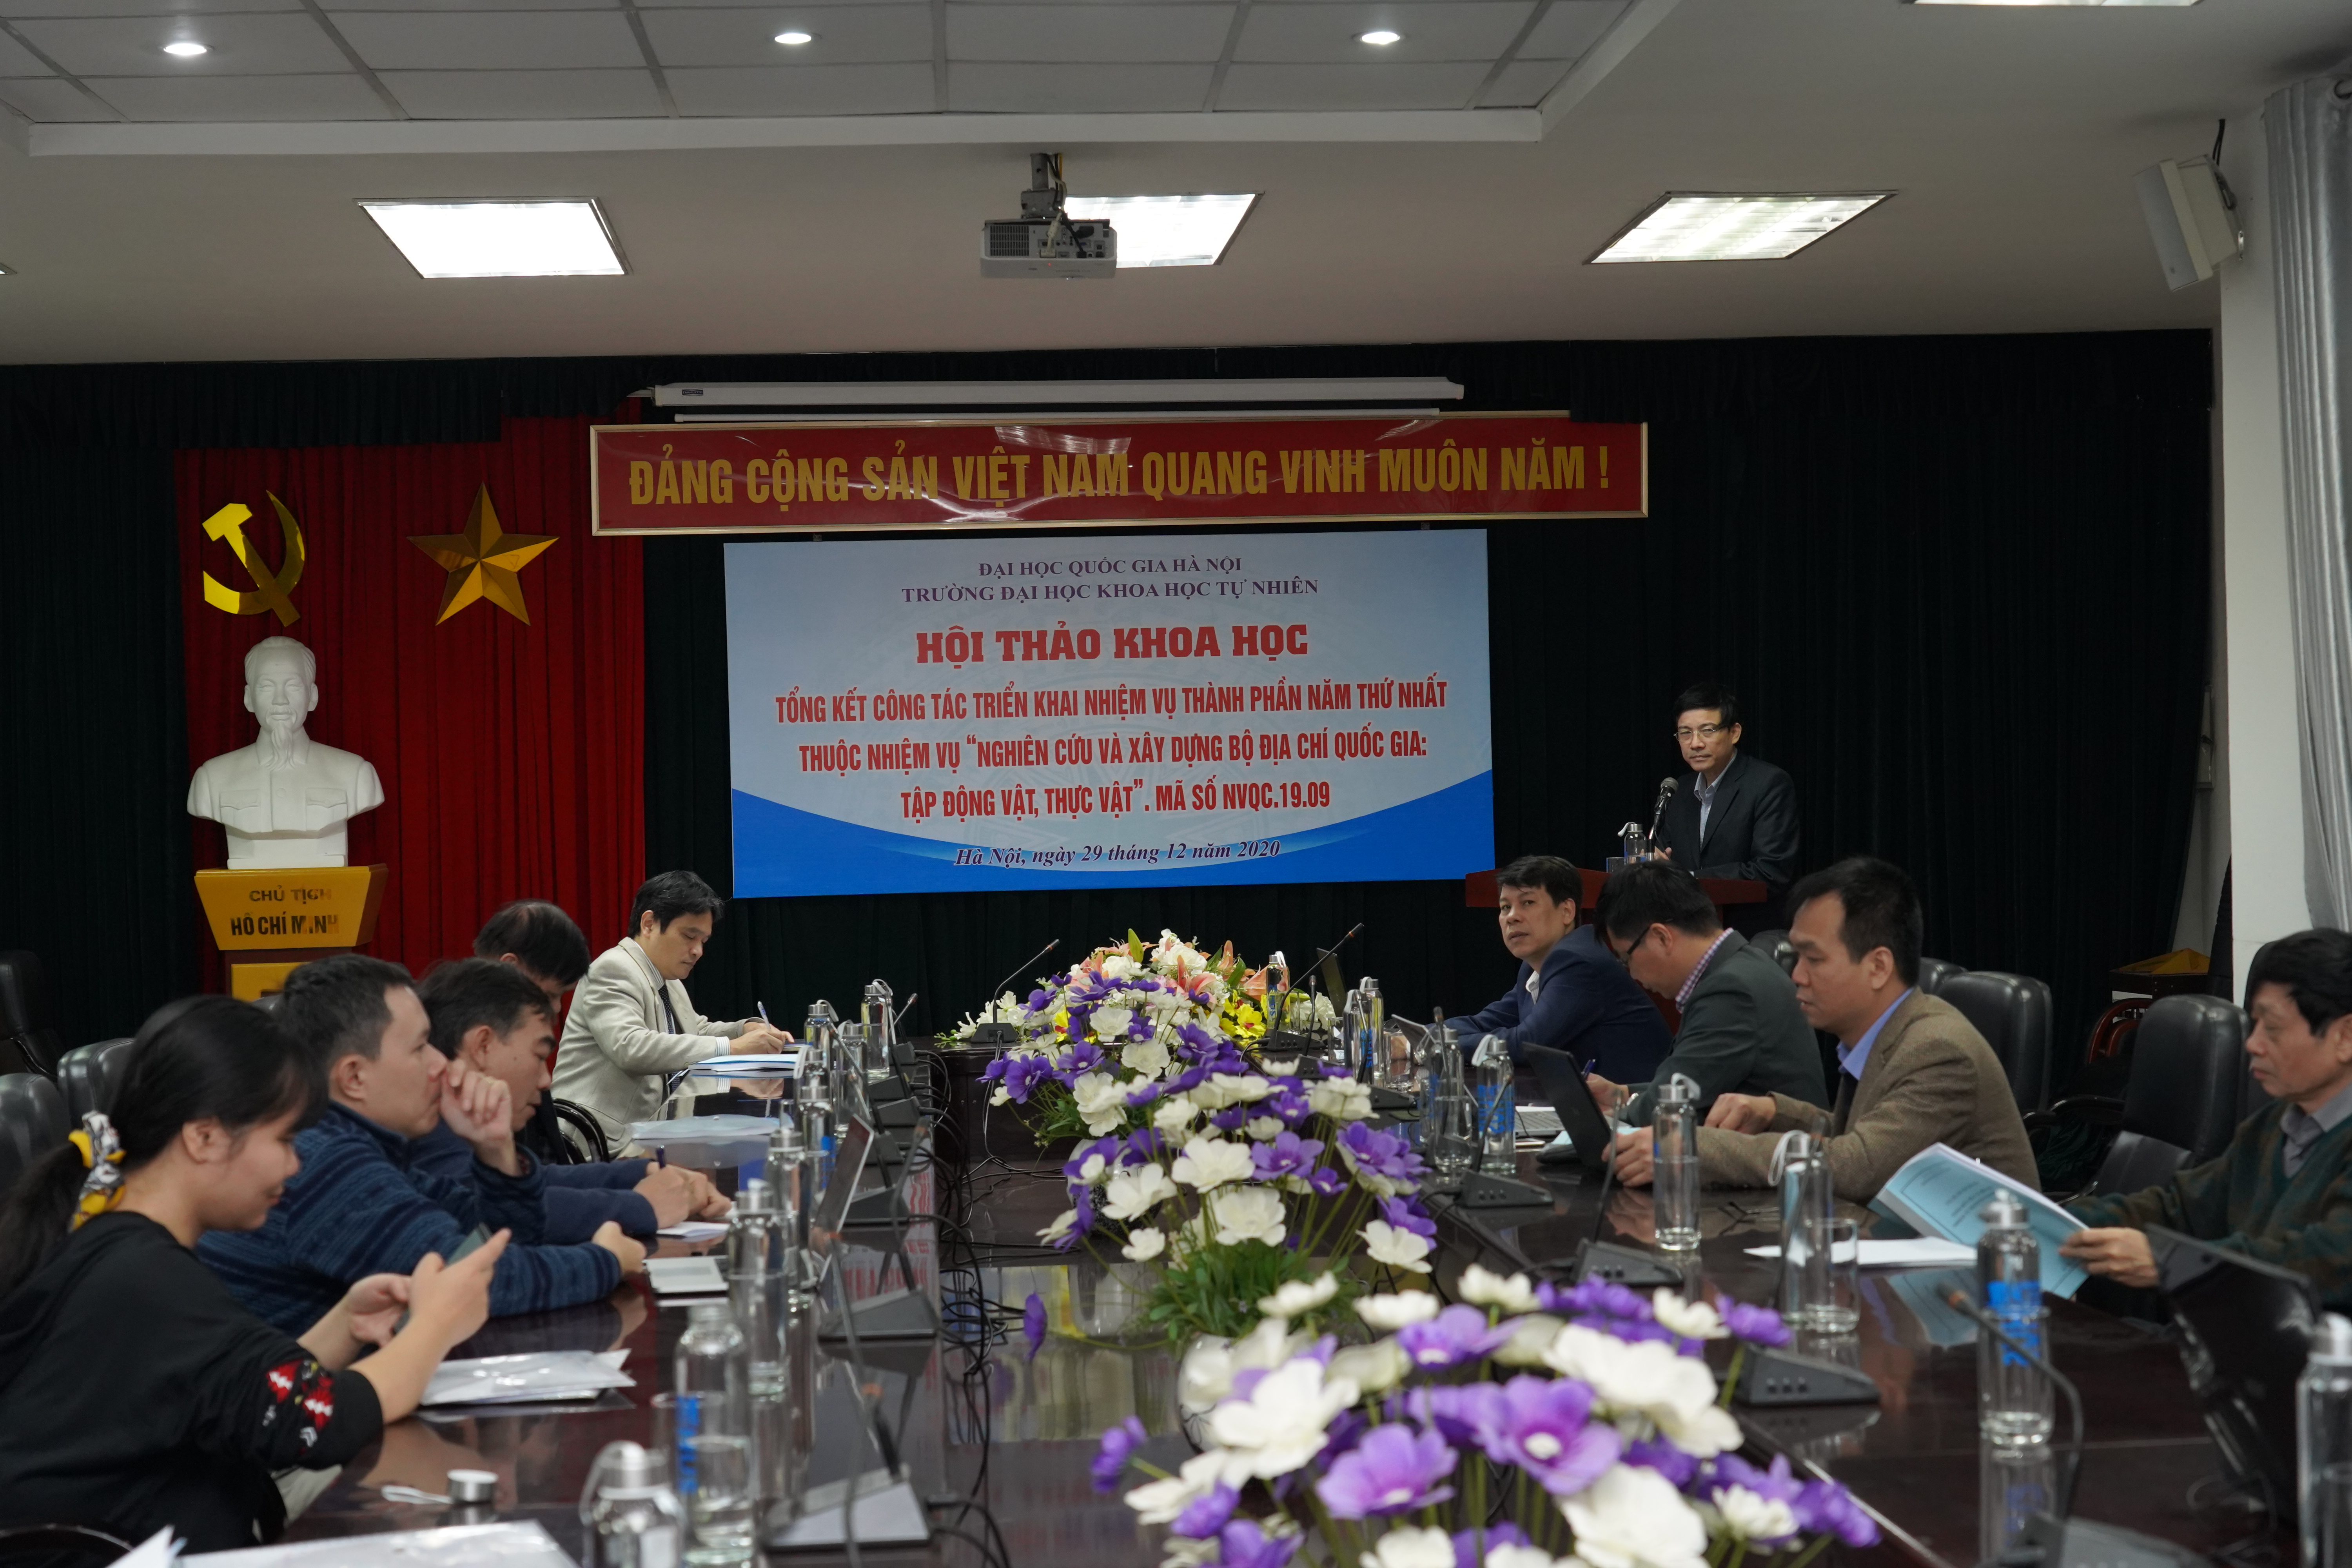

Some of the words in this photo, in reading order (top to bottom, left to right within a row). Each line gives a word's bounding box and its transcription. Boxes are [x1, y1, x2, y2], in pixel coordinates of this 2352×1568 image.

[630, 444, 732, 505] ĐẢNG
[747, 449, 848, 511] CỘNG
[863, 440, 938, 500] SẢN
[953, 446, 1029, 507] VIỆT
[1044, 454, 1128, 497] NAM
[1143, 450, 1267, 501] QUANG
[1279, 450, 1365, 493] VINH
[1379, 438, 1487, 492] MUÔN
[1501, 438, 1584, 490] NĂM
[1600, 446, 1609, 488] !
[979, 563, 1013, 578] ĐẠI
[1020, 561, 1063, 577] HỌC
[1069, 557, 1126, 575] QUỐC
[1132, 559, 1168, 573] GIA
[1172, 555, 1200, 572] HÀ
[1206, 557, 1242, 575] NỘI
[902, 583, 994, 603] TRƯỜNG
[1001, 586, 1038, 603] ĐẠI
[1045, 585, 1091, 602] HỌC
[1097, 584, 1159, 599] KHOA
[1164, 582, 1210, 600] HỌC
[1216, 579, 1247, 599] TỰ
[1252, 575, 1318, 595] NHIÊN
[916, 625, 984, 669] HỘI
[995, 620, 1101, 662] THẢO
[1113, 626, 1221, 659] KHOA
[1232, 624, 1308, 661] HỌC
[775, 686, 826, 723] TỔNG
[832, 687, 867, 722] KẾT
[873, 689, 925, 721] CÔNG
[931, 687, 967, 719] TÁC
[973, 681, 1028, 719] TRIỂN
[1034, 690, 1078, 717] KHAI
[1084, 683, 1147, 721] NHIỆM
[1152, 688, 1176, 720] VỤ
[1181, 681, 1244, 713] THÀNH
[1250, 676, 1302, 711] PHẦN
[1308, 679, 1351, 710] NĂM
[1357, 677, 1394, 709] THỨ
[1398, 672, 1447, 708] NHẤT
[799, 739, 861, 777] THUỘC
[867, 737, 930, 775] NHIỆM
[935, 742, 960, 774] VỤ
[966, 734, 1049, 768] “NGHIÊN
[1054, 733, 1093, 765] CỨU
[1098, 732, 1123, 764] VÀ
[1128, 731, 1165, 763] XÂY
[1171, 733, 1223, 768] DỰNG
[1229, 729, 1254, 766] BỘ
[1259, 734, 1292, 766] ĐỊA
[1297, 727, 1328, 759] CHÍ
[1334, 722, 1385, 761] QUỐC
[1390, 730, 1427, 757] GIA:
[900, 786, 937, 824] TẬP
[942, 784, 995, 822] ĐỘNG
[1000, 784, 1039, 821] VẬT,
[1044, 784, 1093, 820] THỰC
[1155, 780, 1186, 811] MÃ
[1192, 774, 1217, 810] SỐ
[1223, 780, 1330, 812] NVQC.19.09
[955, 848, 983, 865] Hà
[988, 848, 1025, 868] Nội,
[1032, 846, 1076, 867] ngày
[1081, 845, 1102, 862] 29
[1108, 844, 1160, 864] tháng
[1165, 843, 1187, 859] 12
[1192, 842, 1231, 858] năm
[1237, 840, 1281, 857] 2020
[249, 885, 285, 902] CHỦ
[290, 888, 332, 904] TỊCH
[258, 911, 287, 935] CHÍ
[291, 915, 339, 935] MINH
